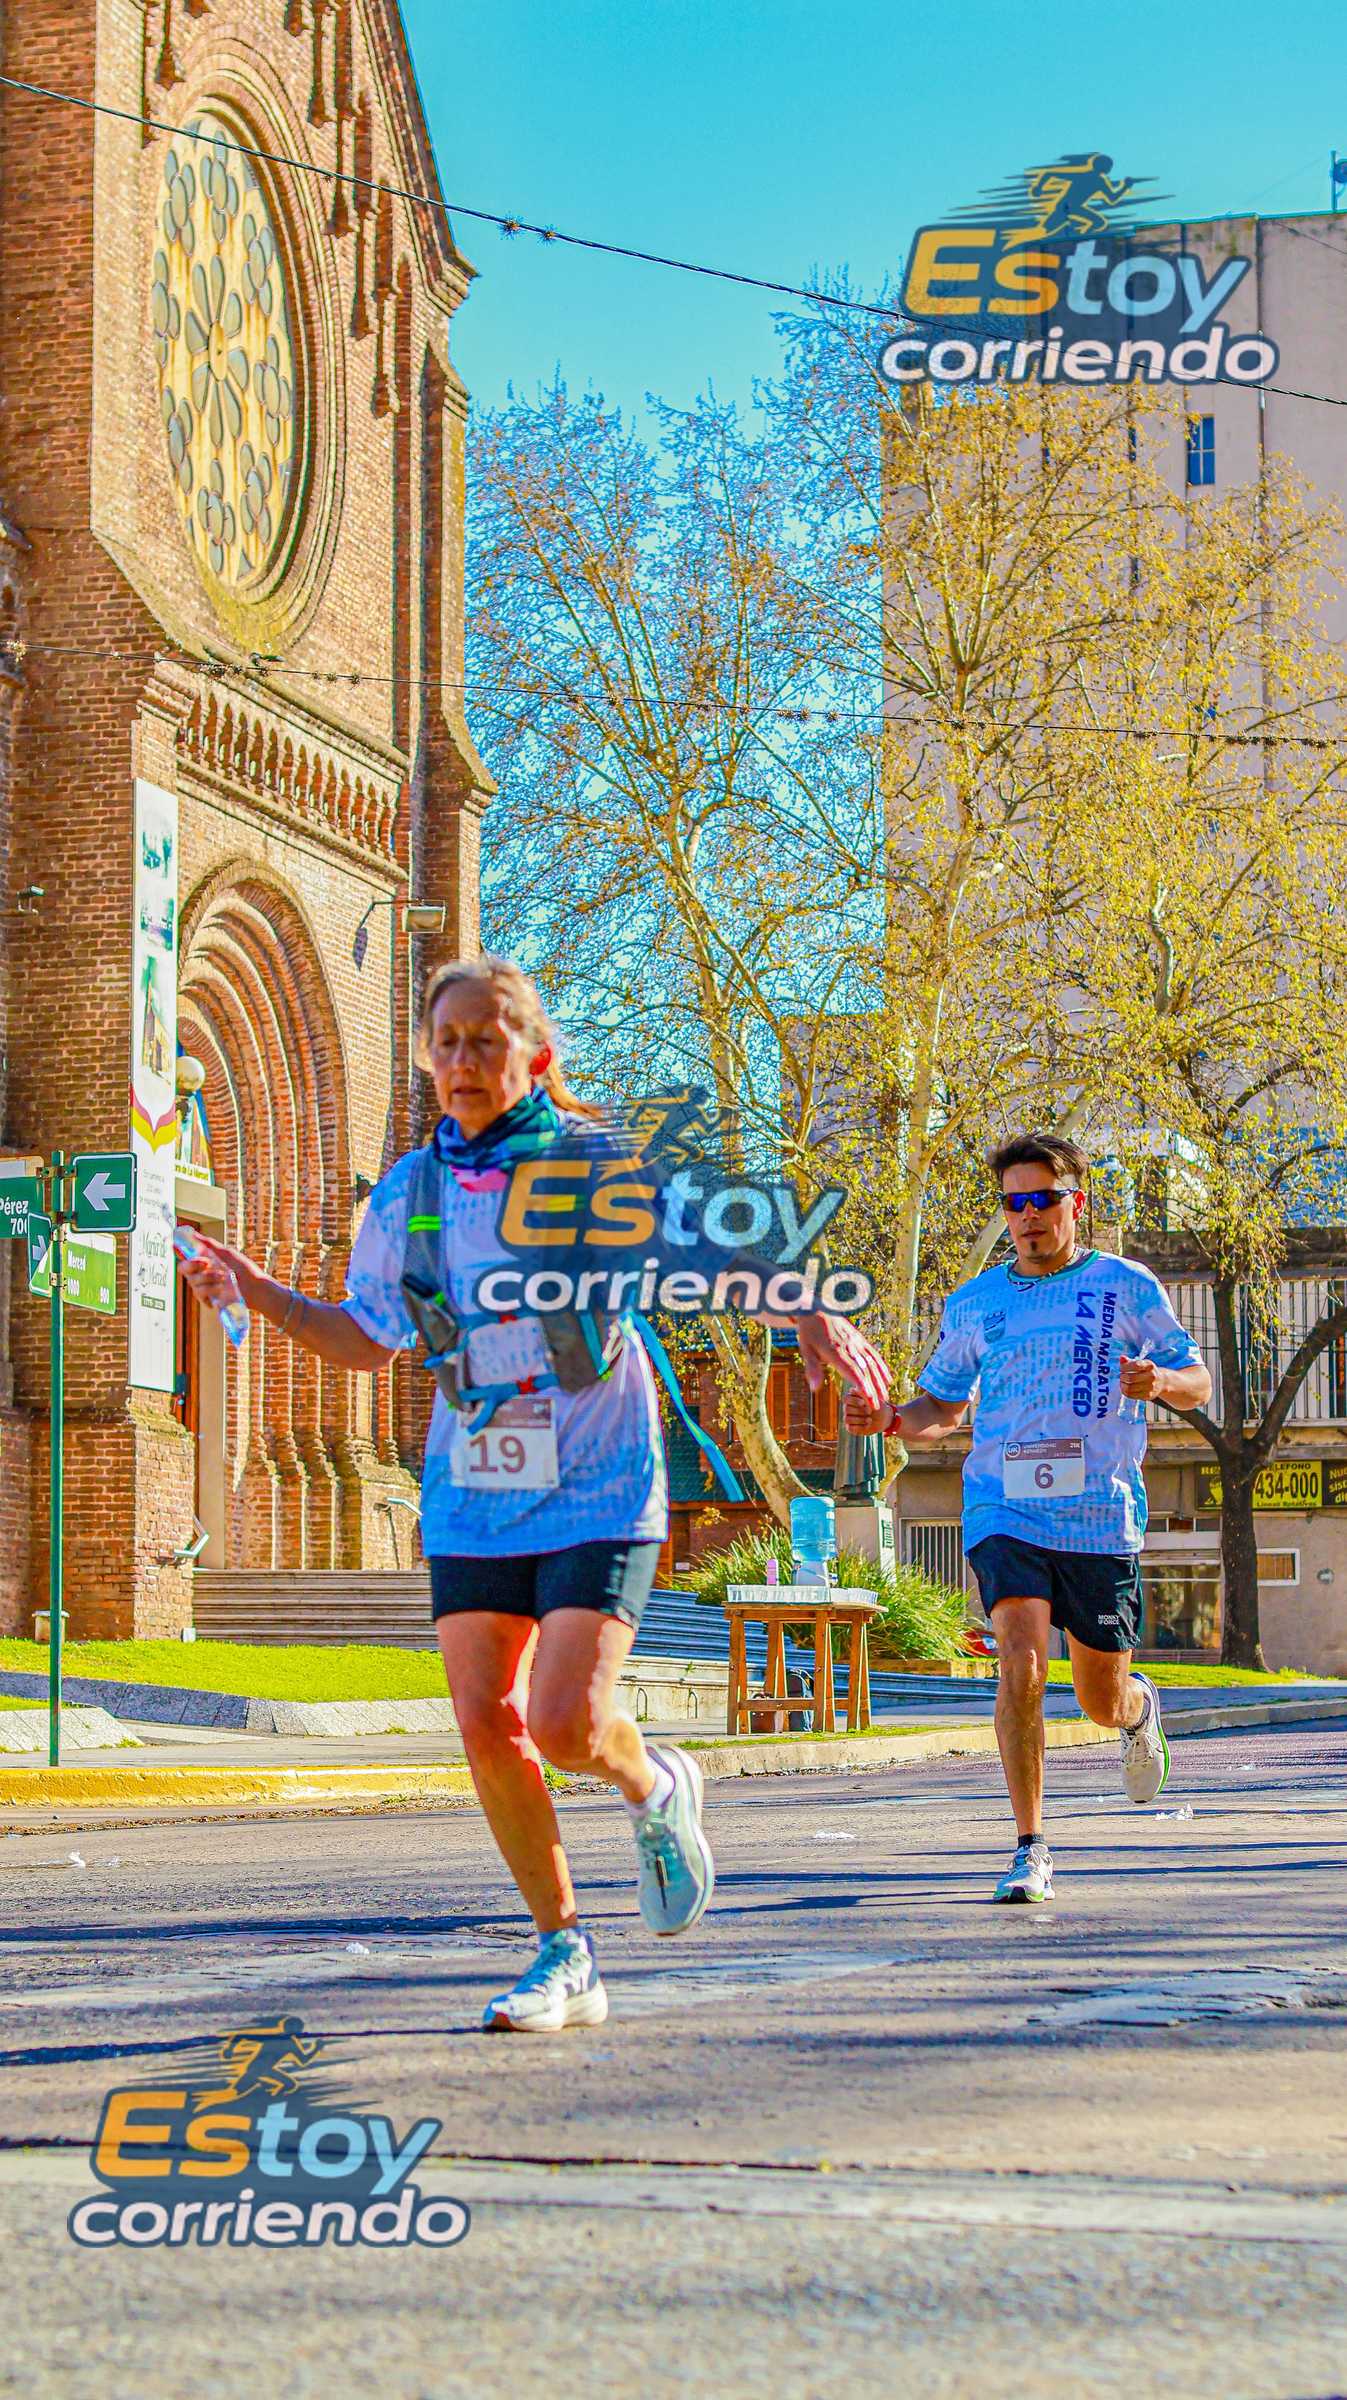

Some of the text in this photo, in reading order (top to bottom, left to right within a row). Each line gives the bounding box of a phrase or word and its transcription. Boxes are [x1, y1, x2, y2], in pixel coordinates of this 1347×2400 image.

[1073, 1291, 1096, 1417] LA MERCED
[1097, 1291, 1117, 1418] MEDIA MARATON
[470, 1434, 525, 1473] 19
[1034, 1463, 1054, 1489] 6
